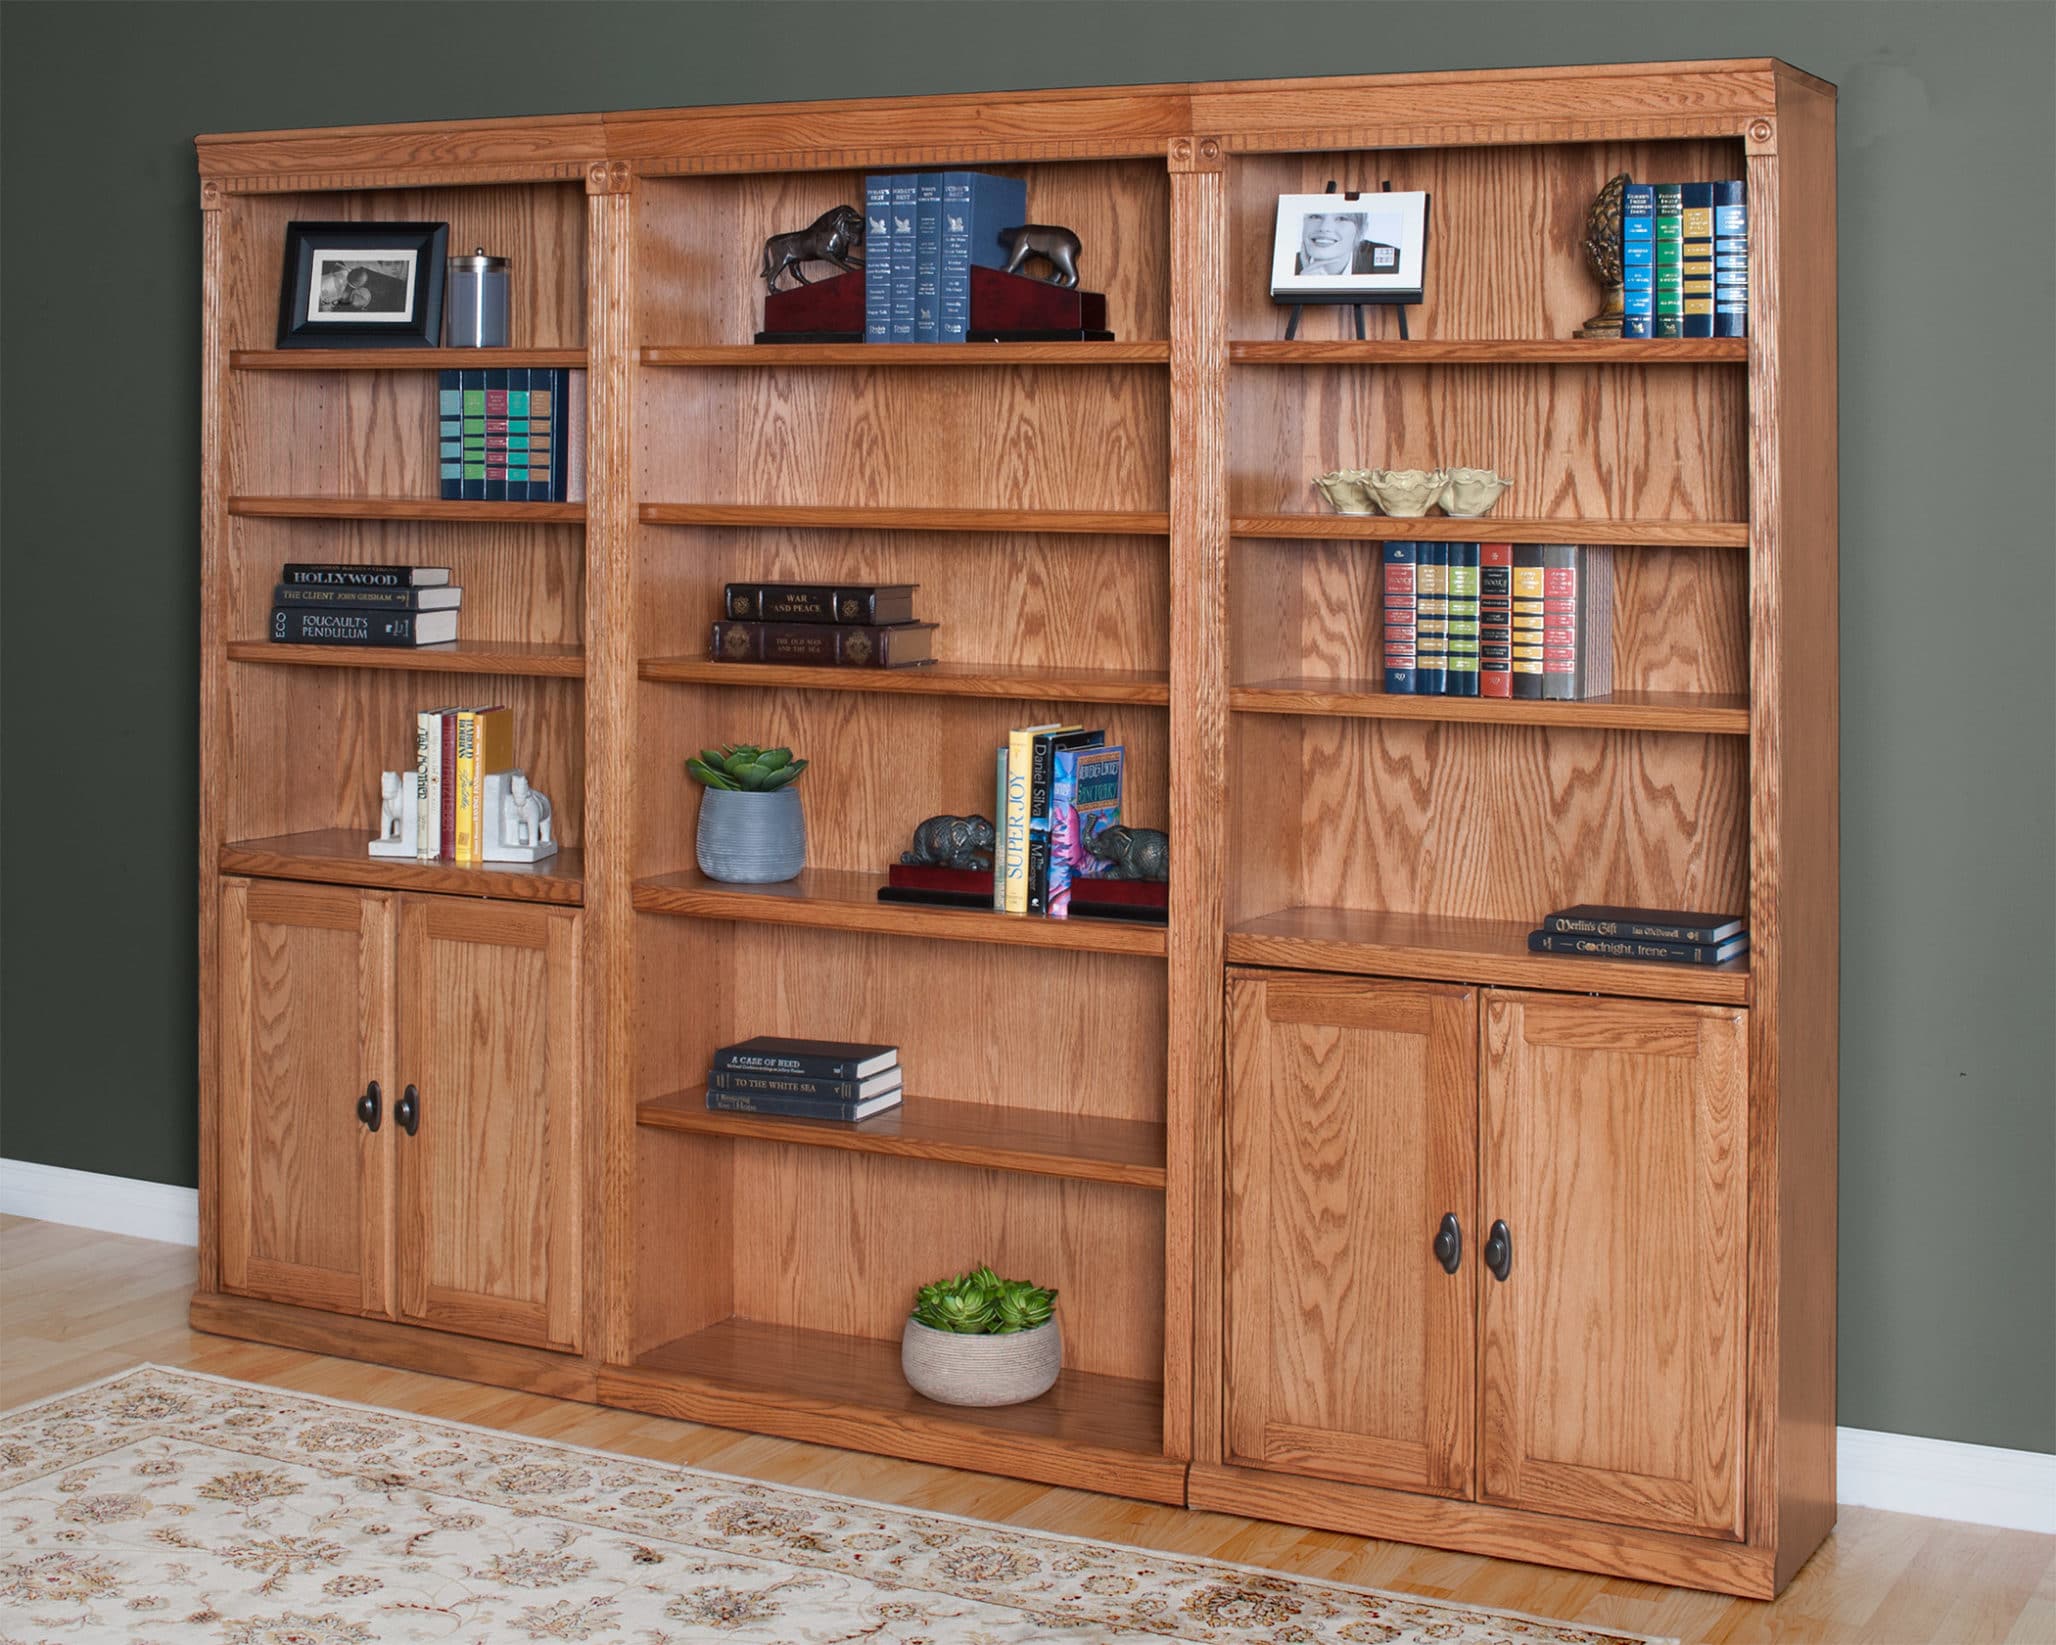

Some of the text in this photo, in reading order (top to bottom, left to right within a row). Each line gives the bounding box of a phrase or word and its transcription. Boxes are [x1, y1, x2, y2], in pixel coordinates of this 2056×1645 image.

[294, 571, 398, 585] HOLLYWOOD
[283, 591, 301, 599] THE
[302, 591, 334, 600] CLIENT
[786, 594, 808, 603] WAR
[774, 604, 821, 613] AND PEACE
[275, 612, 286, 638] ECO
[302, 615, 368, 628] FOUCAULT'S
[302, 626, 368, 639] PENDULUM
[1031, 744, 1047, 817] Daniel Silva
[1007, 770, 1025, 880] SUPER JOY
[1555, 919, 1596, 933] Merlin's
[1597, 922, 1617, 936] Gift
[1576, 941, 1668, 957] Goodnight, Irene
[731, 1056, 800, 1068] A CASE OF NEED
[735, 1078, 816, 1093] TO THE WHITE SEA
